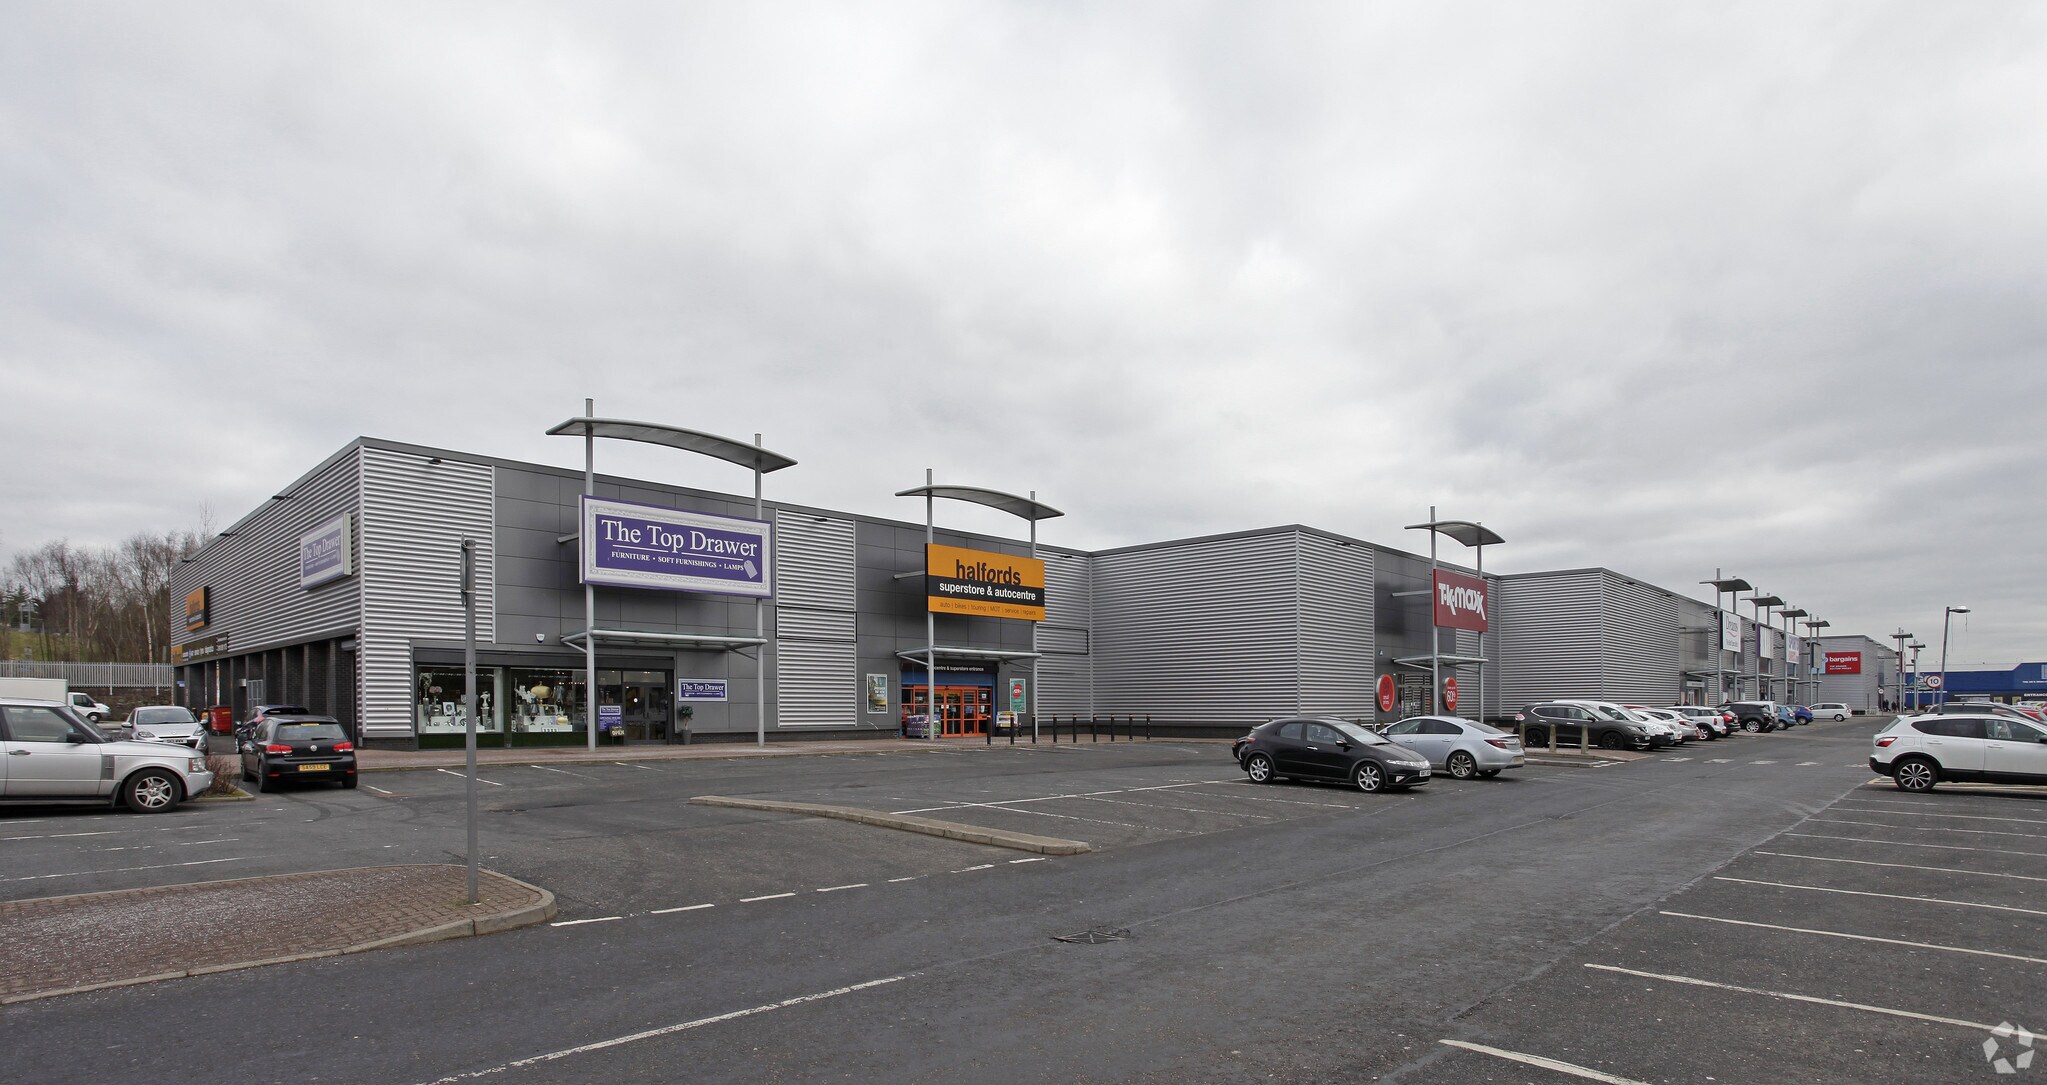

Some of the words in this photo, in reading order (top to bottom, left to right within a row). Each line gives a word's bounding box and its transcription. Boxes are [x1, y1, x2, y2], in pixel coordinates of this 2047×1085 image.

[303, 546, 312, 560] The
[312, 543, 321, 558] Top
[322, 535, 340, 552] Drawer
[601, 519, 641, 543] The
[647, 525, 684, 553] Top
[690, 530, 757, 557] Drawer
[611, 551, 650, 561] FURNITURE
[658, 556, 675, 564] SOFT
[675, 558, 717, 568] FURNISHINGS
[724, 563, 744, 571] LAMPS
[956, 559, 1021, 585] halfords
[940, 582, 985, 595] superstore
[987, 585, 993, 596] &
[994, 588, 1036, 600] autocentre
[971, 604, 986, 612] touring
[693, 684, 704, 692] Top
